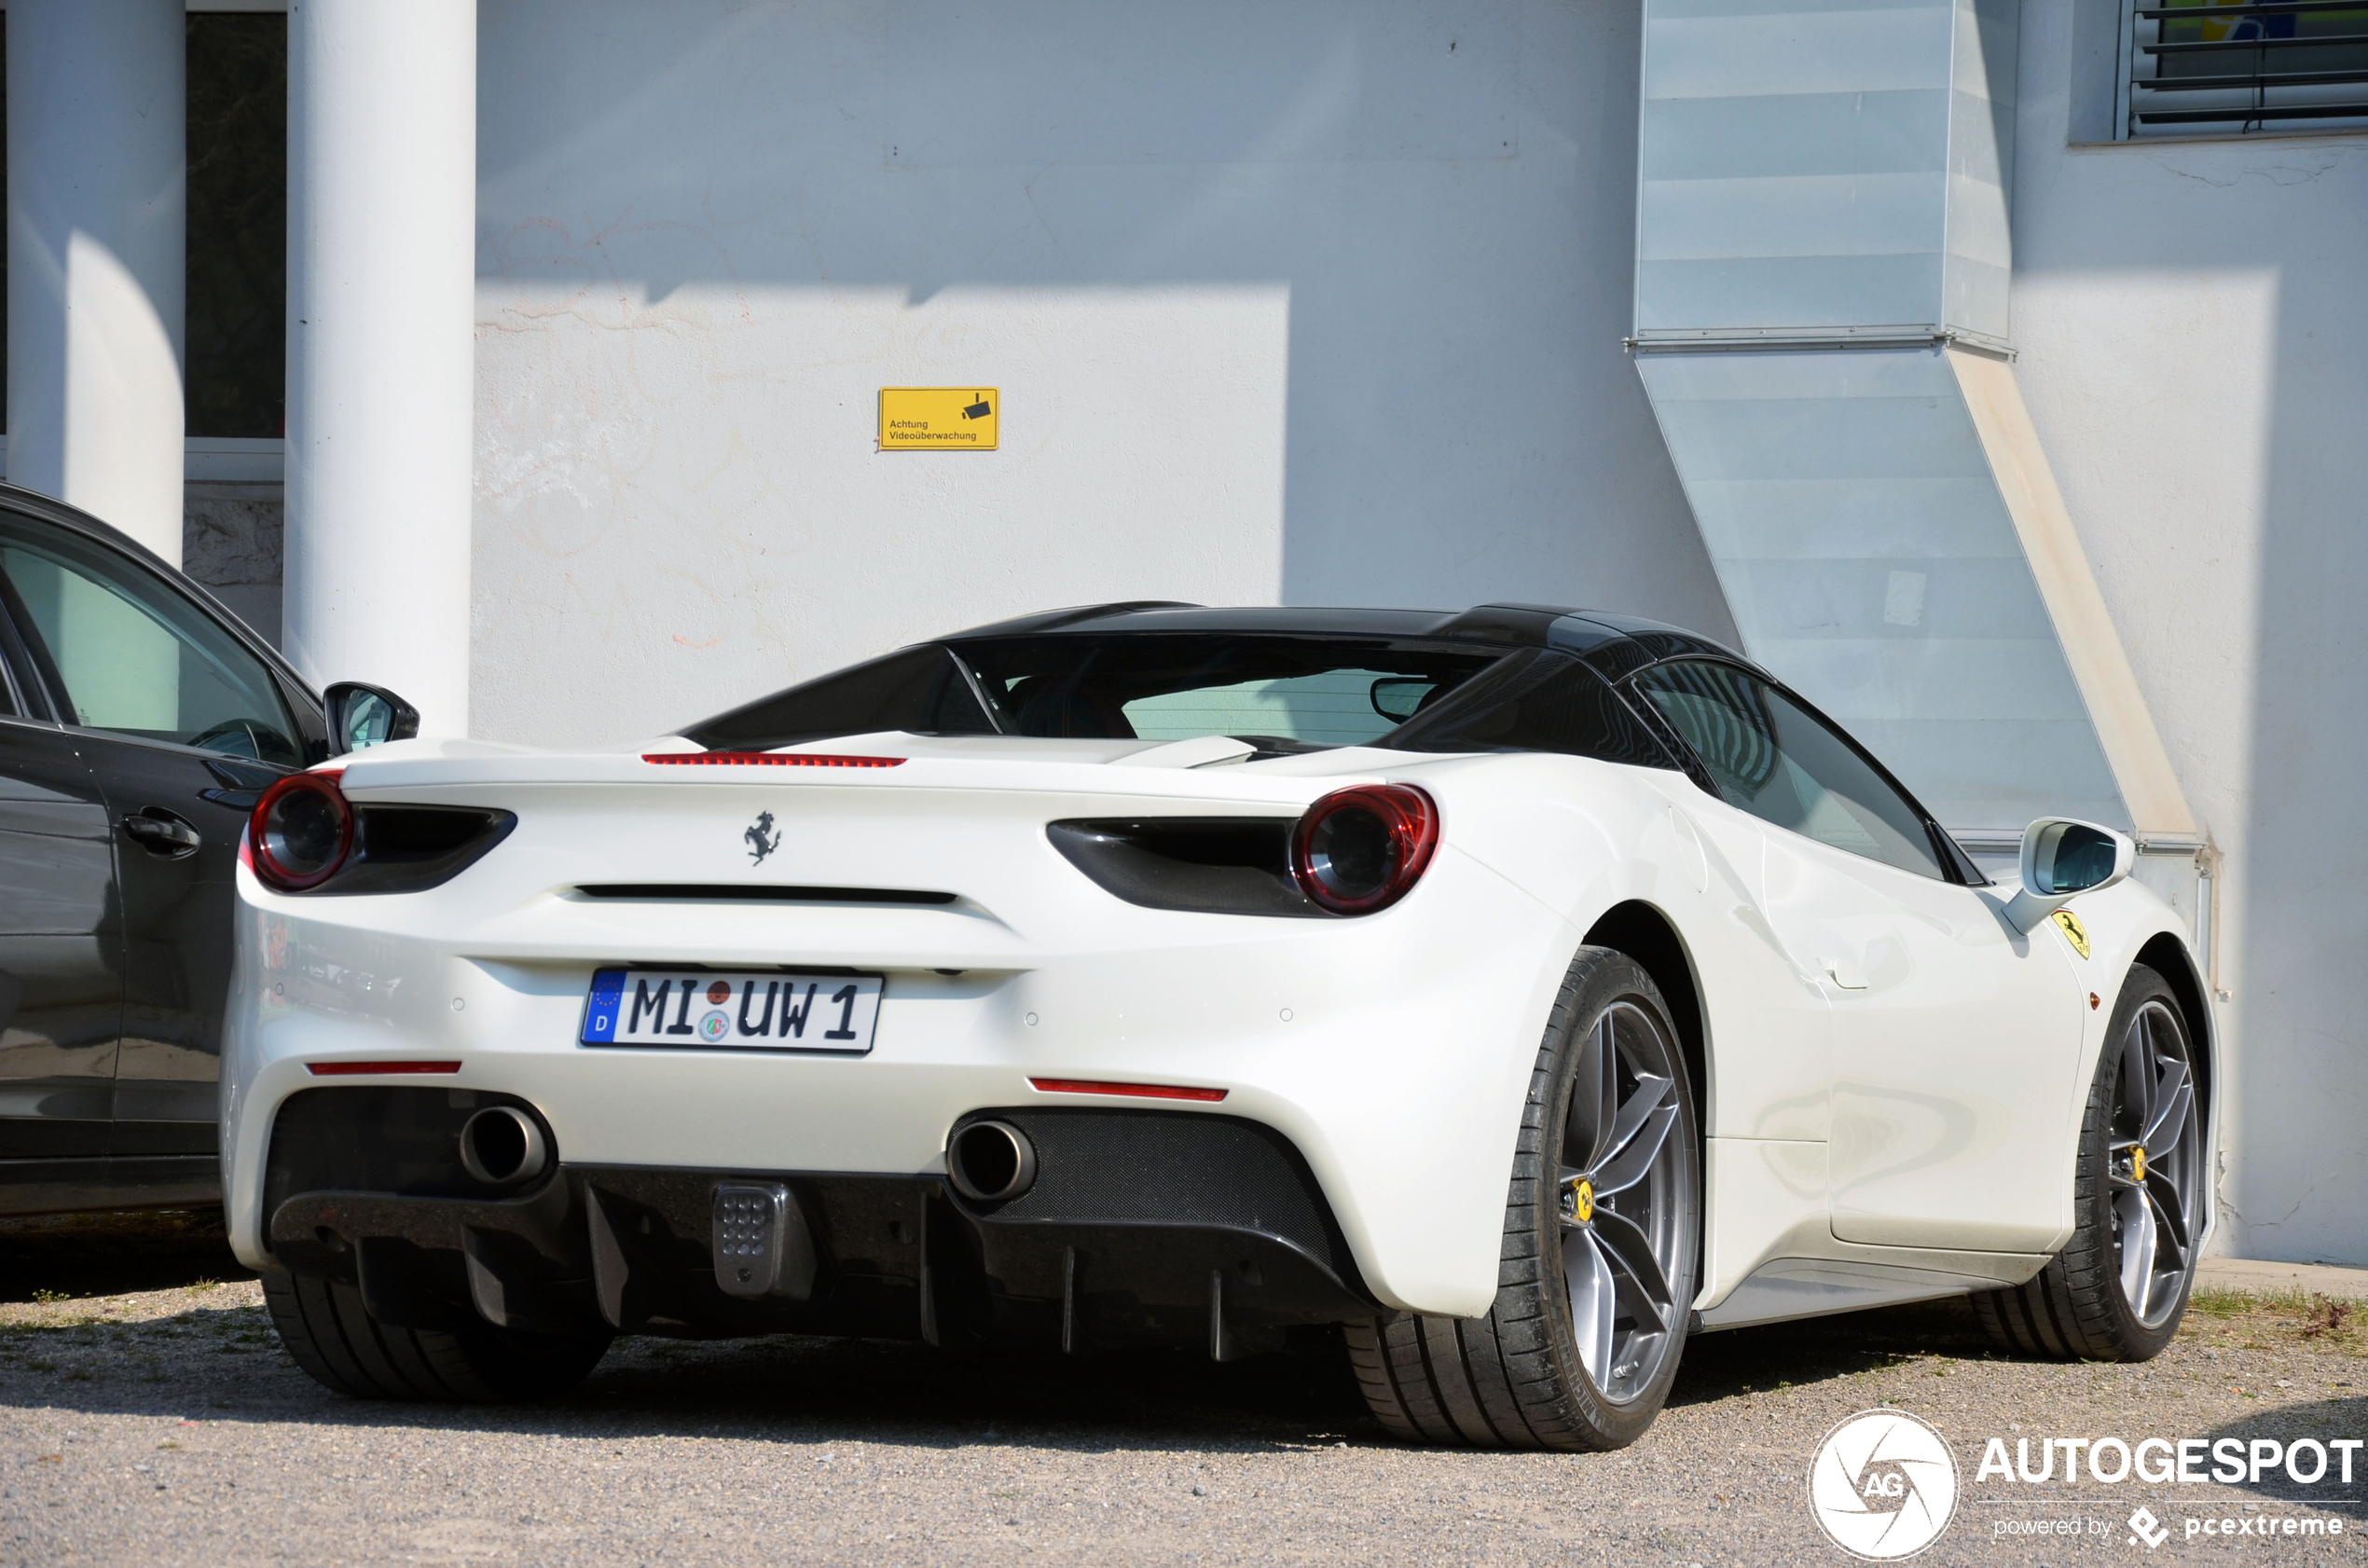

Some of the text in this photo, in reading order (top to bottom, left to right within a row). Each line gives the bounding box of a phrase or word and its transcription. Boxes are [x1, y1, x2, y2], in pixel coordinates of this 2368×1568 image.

[889, 420, 929, 430] Achtung
[889, 431, 977, 442] Videoüberwachung
[627, 979, 697, 1036] MI
[737, 981, 818, 1038] UW
[823, 984, 858, 1040] 1
[596, 1015, 608, 1032] D
